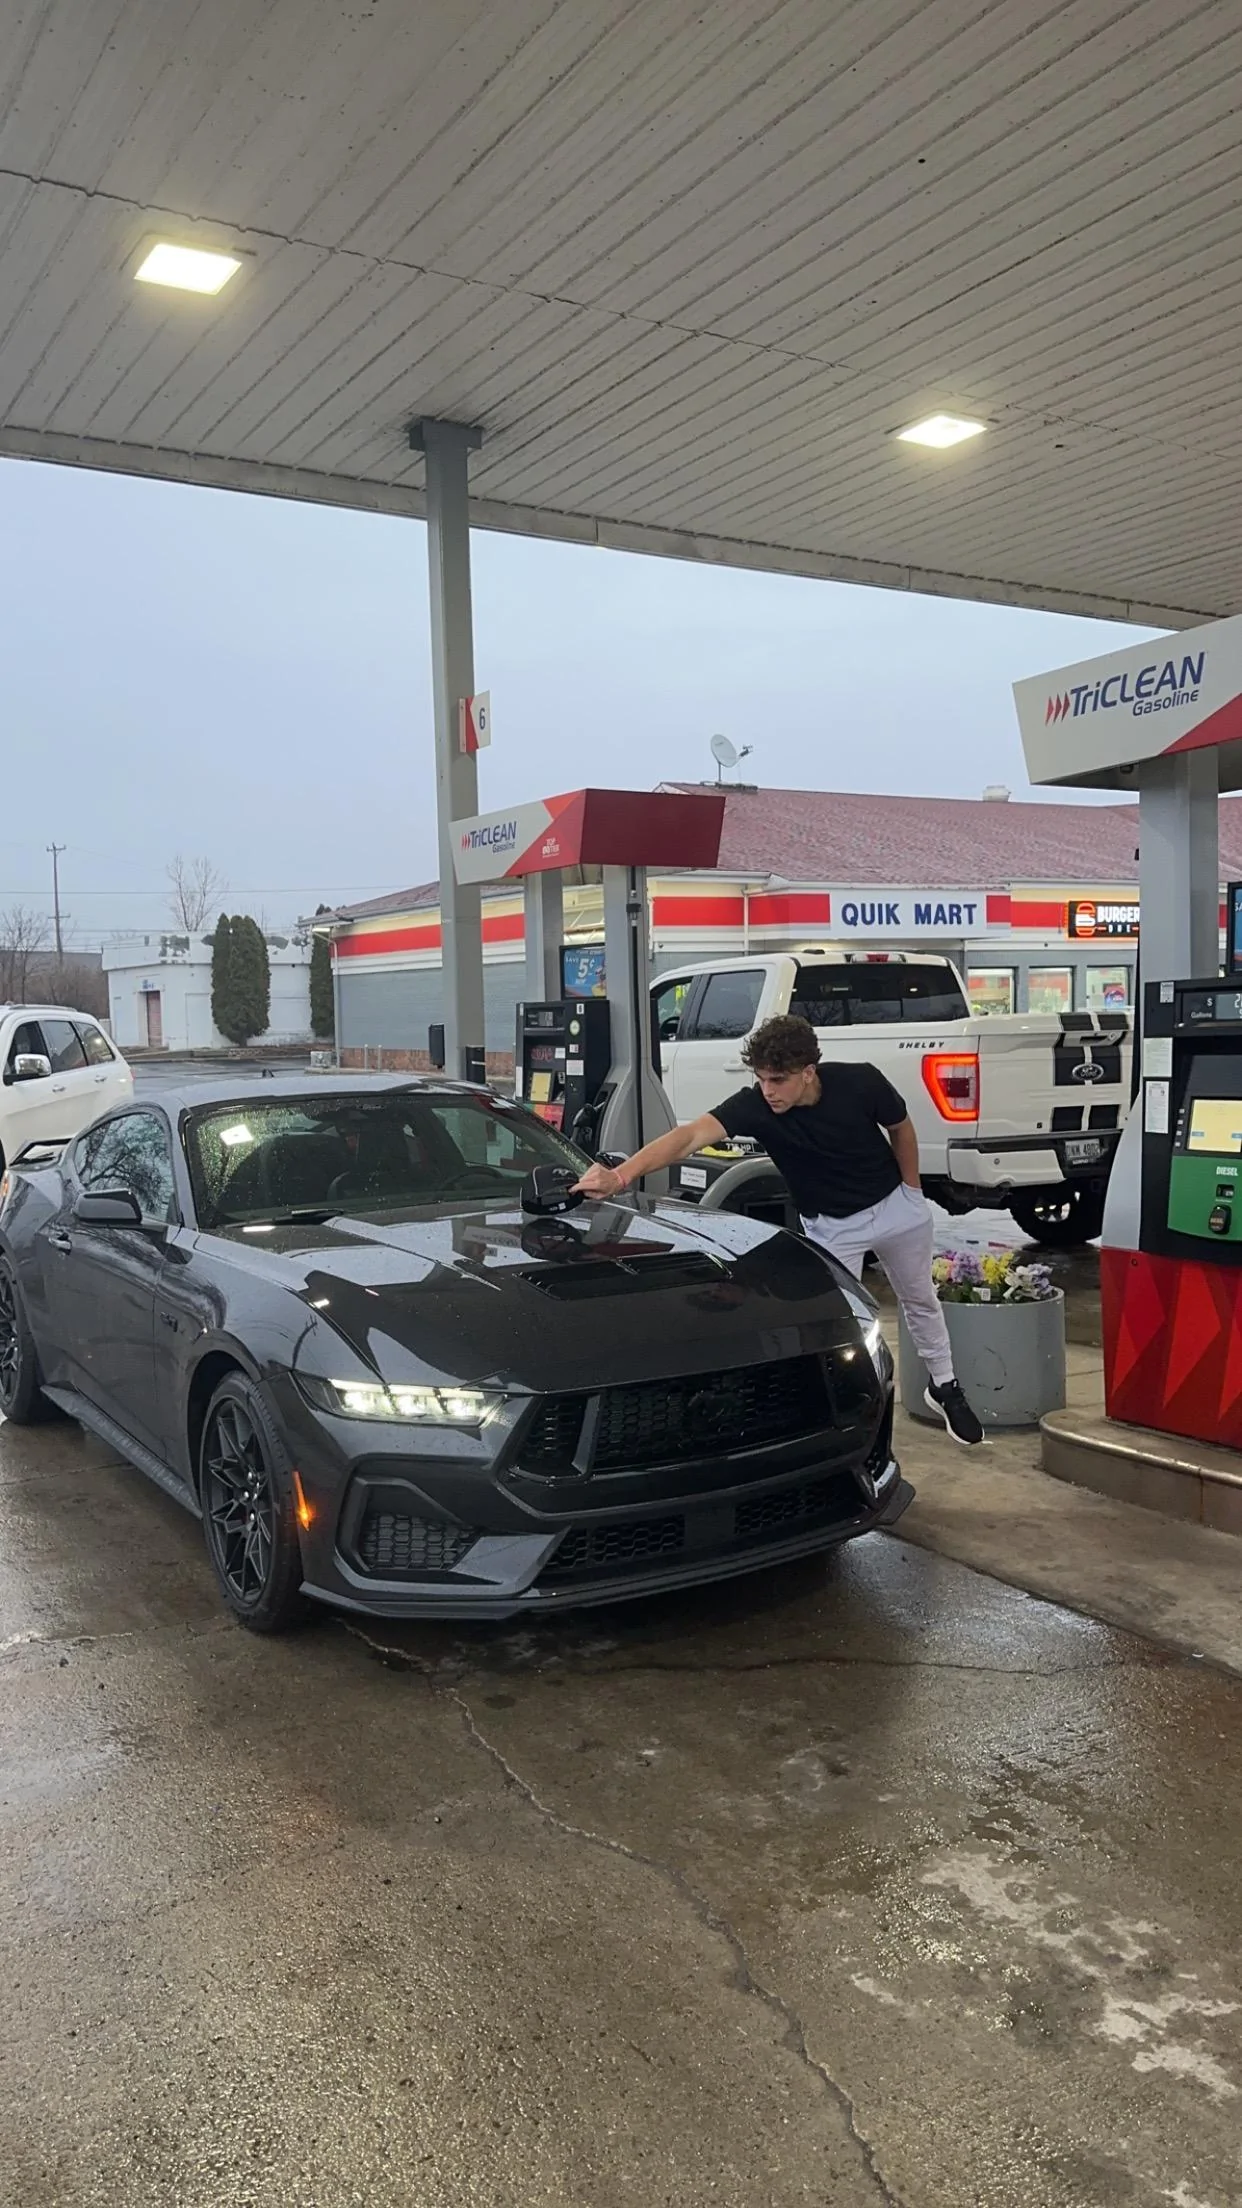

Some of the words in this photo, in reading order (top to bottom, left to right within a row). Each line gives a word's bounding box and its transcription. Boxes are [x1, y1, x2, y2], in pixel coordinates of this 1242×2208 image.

[1070, 651, 1206, 717] TriCLEAN
[1132, 688, 1200, 717] Gasoline
[479, 707, 486, 730] 6
[470, 820, 517, 849] TriCLEAN
[841, 902, 901, 927] QUIK
[914, 903, 978, 925] MART
[1096, 905, 1140, 923] BURGER
[898, 1041, 945, 1049] SHELBY
[1215, 1166, 1239, 1176] DIESEL
